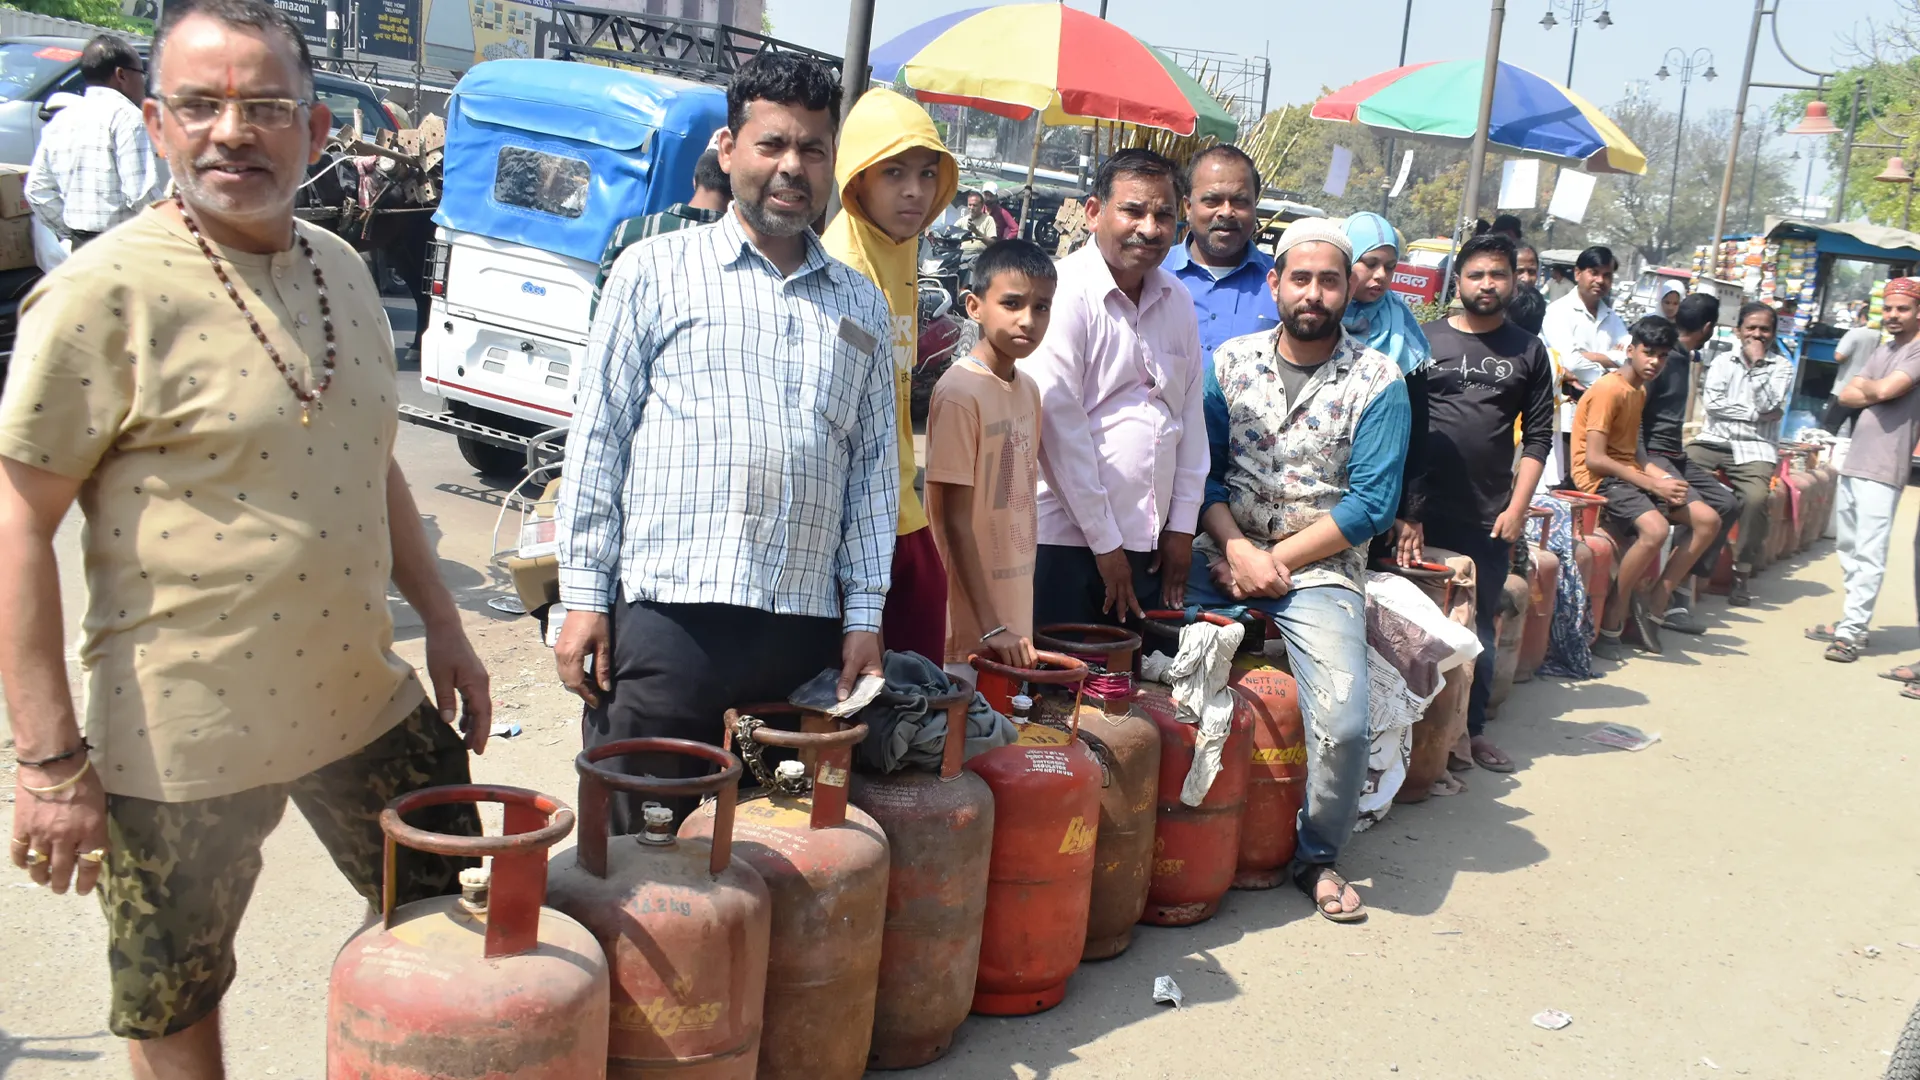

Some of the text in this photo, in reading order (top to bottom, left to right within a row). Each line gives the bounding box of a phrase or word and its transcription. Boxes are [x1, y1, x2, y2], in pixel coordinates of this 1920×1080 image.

[274, 0, 310, 15] amazon
[1245, 676, 1270, 685] NETT
[1275, 686, 1286, 698] kg
[670, 897, 691, 917] kg
